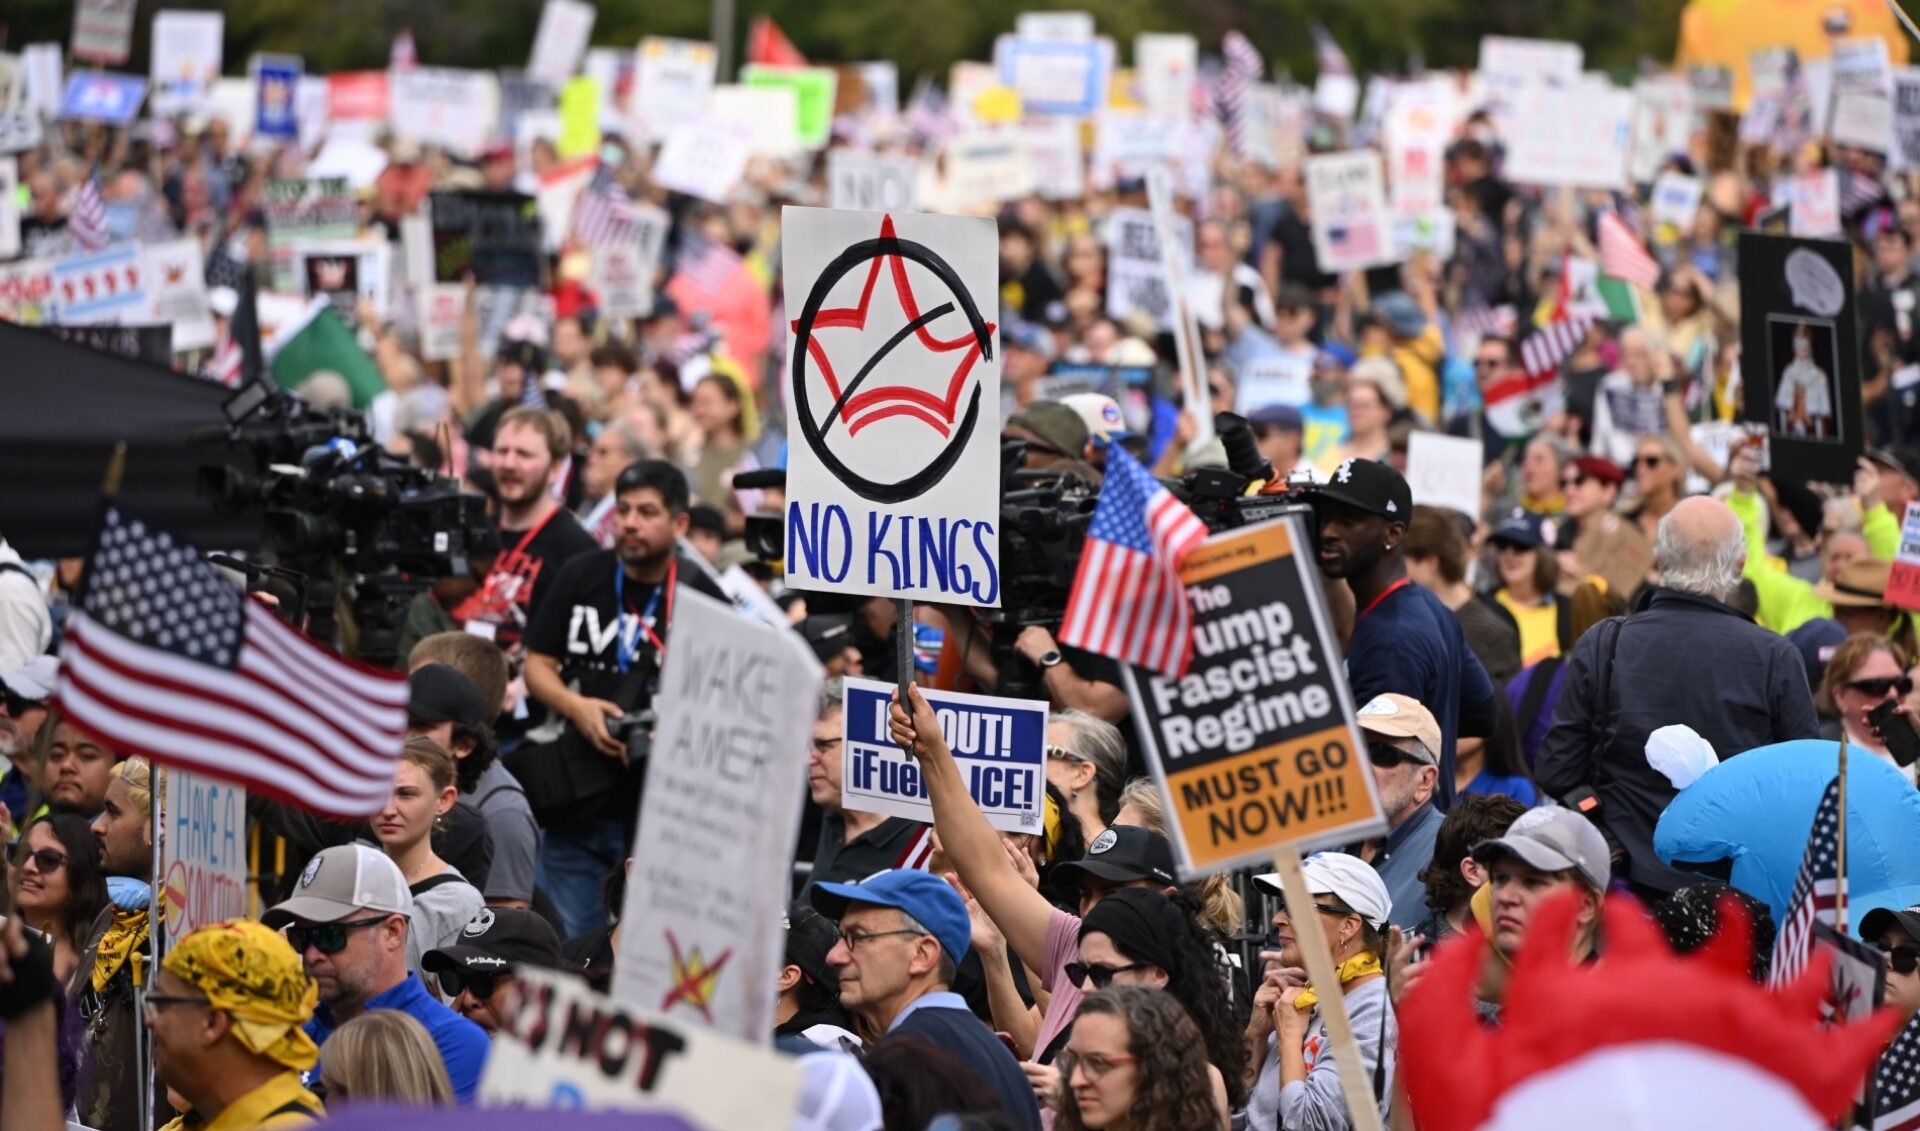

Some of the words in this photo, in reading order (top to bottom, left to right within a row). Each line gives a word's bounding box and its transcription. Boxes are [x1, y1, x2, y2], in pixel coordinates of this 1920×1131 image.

[788, 501, 852, 583] NO
[868, 511, 998, 605] KINGS
[1193, 600, 1294, 656] ump
[1150, 634, 1317, 715] Fascist
[936, 708, 1013, 758] OUT!
[1159, 683, 1332, 759] Regime
[970, 765, 1034, 810] ICE!
[1180, 757, 1281, 811] MUST
[1295, 741, 1348, 773] GO
[1210, 775, 1348, 848] NOW!!!
[176, 771, 218, 864] HAVE
[223, 787, 236, 871] A
[557, 999, 688, 1094] NOT
